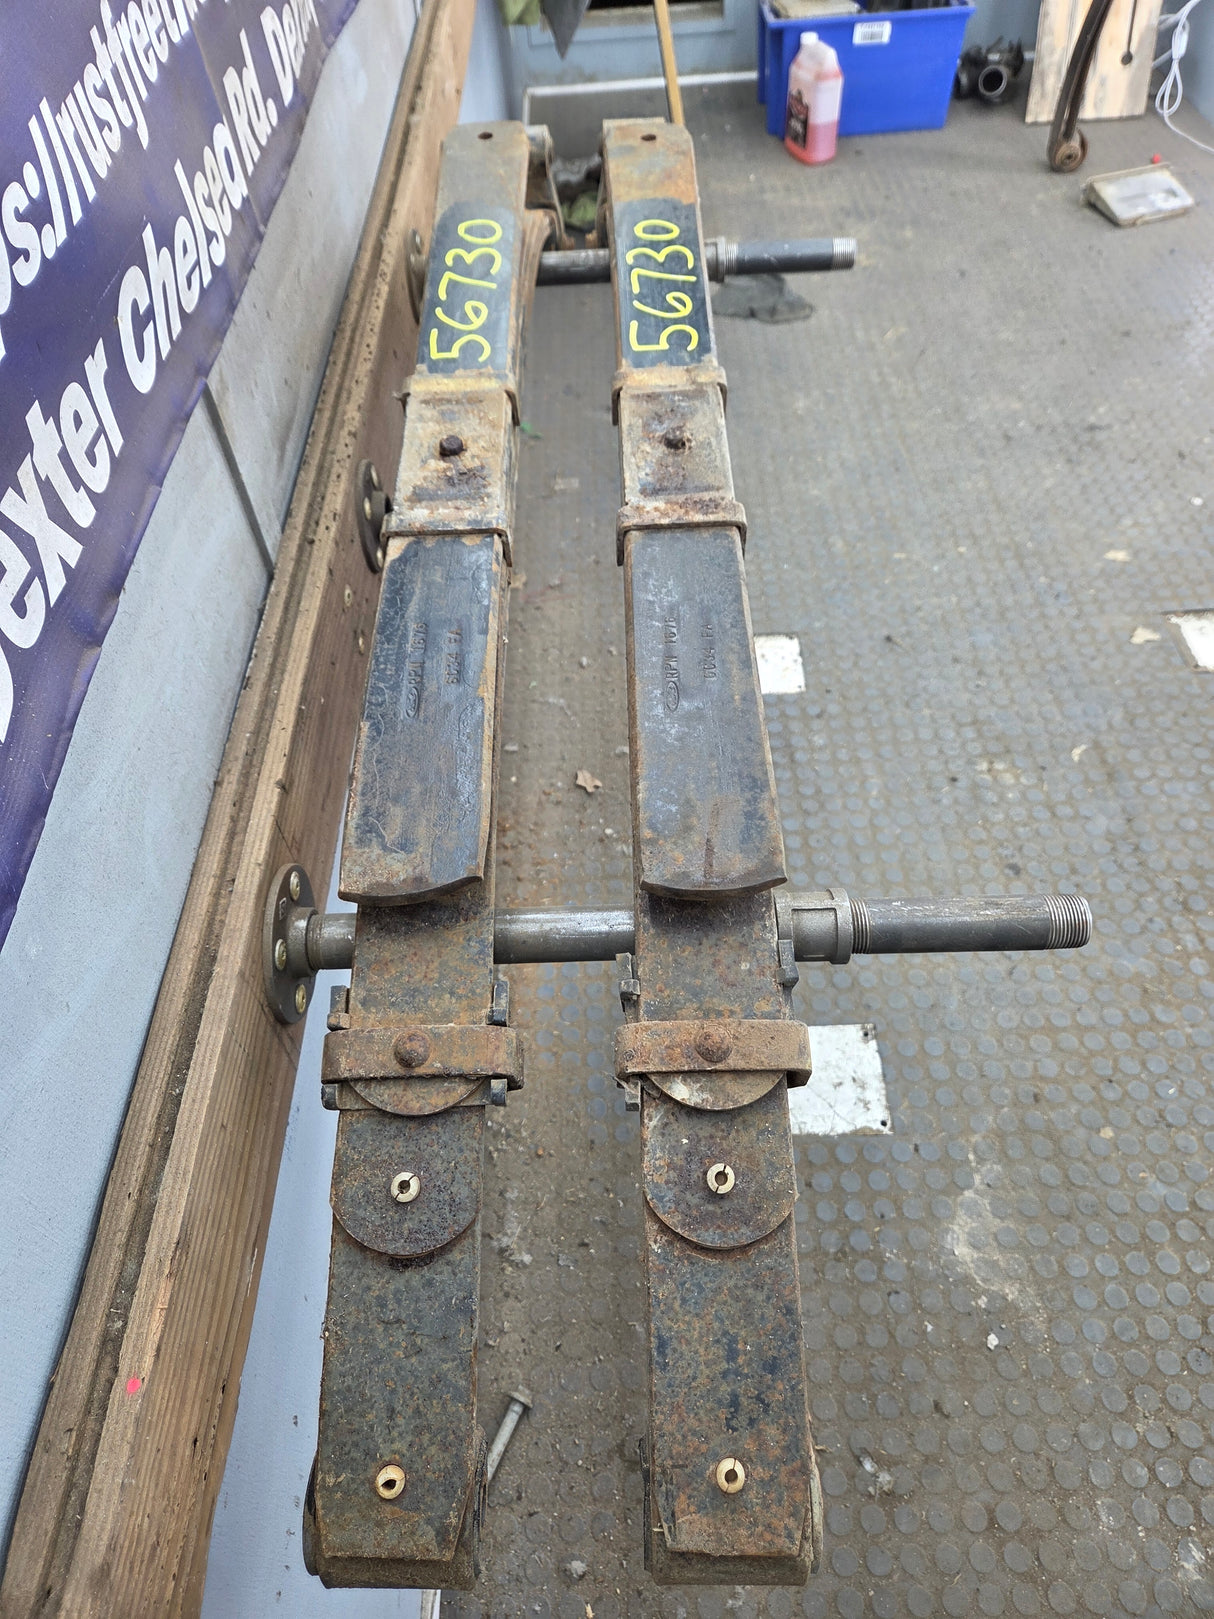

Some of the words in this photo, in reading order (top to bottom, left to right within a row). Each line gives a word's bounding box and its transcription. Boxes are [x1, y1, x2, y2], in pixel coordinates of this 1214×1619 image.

[429, 218, 503, 363] 56730
[625, 218, 699, 352] 56730
[0, 337, 124, 742] exter
[117, 121, 249, 394] Chelsea
[222, 27, 278, 171] Rd.
